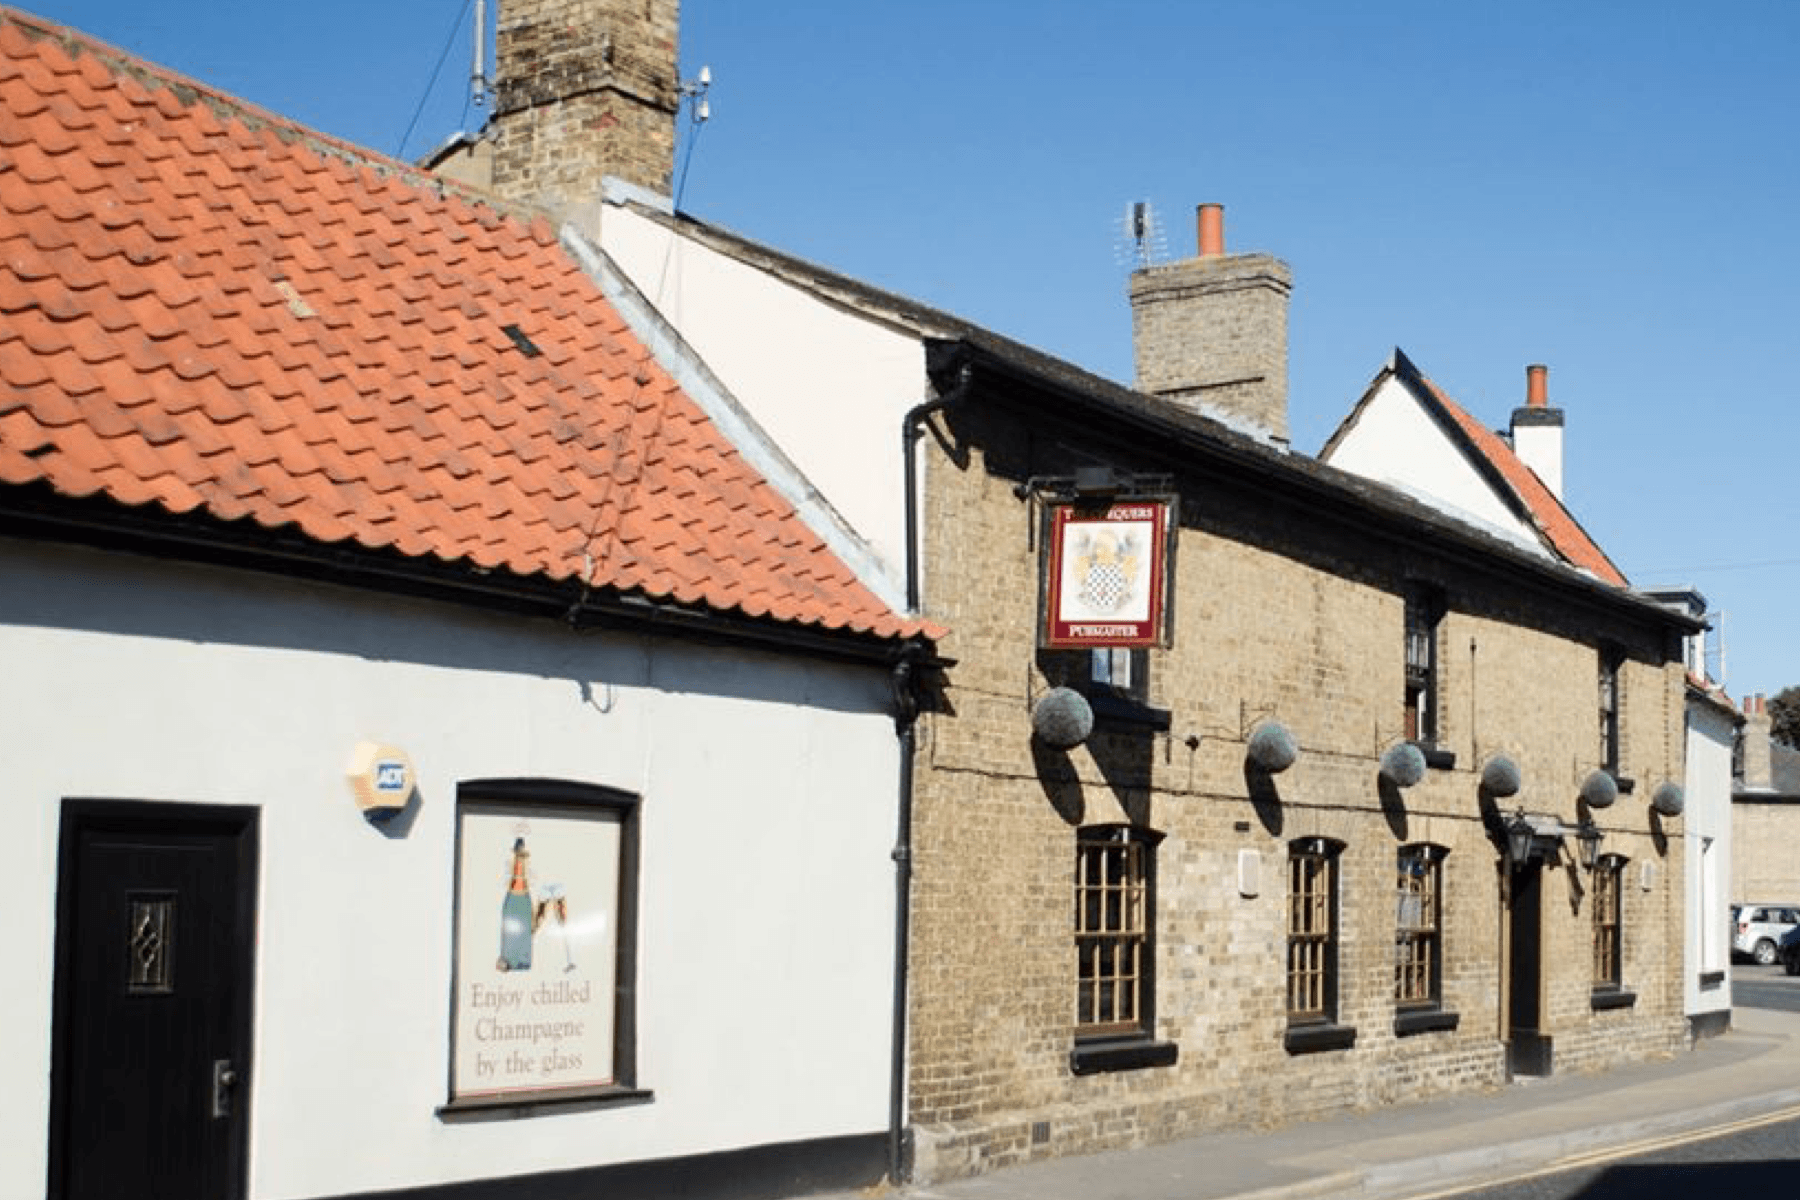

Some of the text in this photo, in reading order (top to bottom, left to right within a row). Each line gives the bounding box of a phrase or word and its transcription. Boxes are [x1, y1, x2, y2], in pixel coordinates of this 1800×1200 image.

[1069, 624, 1138, 637] PUBMASTER
[378, 768, 403, 786] ADT
[471, 980, 591, 1011] Enjoy chilled
[475, 1016, 584, 1045] Champagne
[477, 1047, 583, 1077] by the glass
